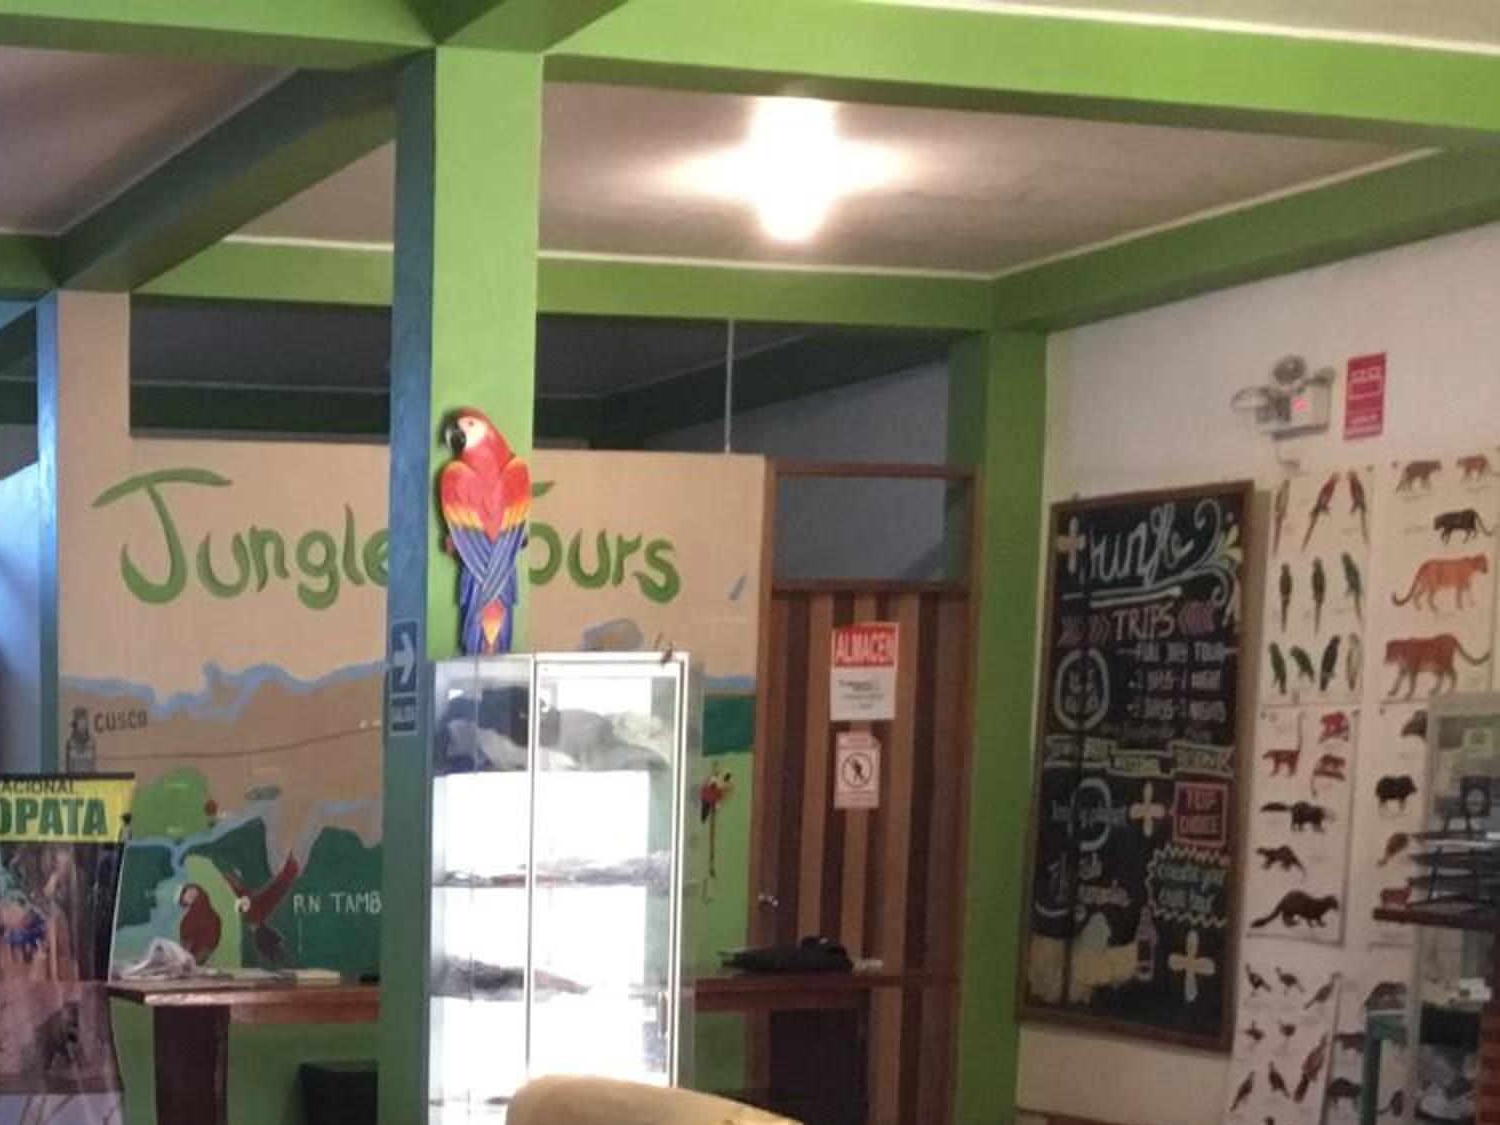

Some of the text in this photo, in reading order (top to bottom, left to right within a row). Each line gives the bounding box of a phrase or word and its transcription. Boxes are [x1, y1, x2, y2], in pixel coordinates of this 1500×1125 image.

[90, 467, 680, 611] Jungle ours
[1113, 602, 1176, 641] TRIPS
[94, 709, 148, 733] CUSCO
